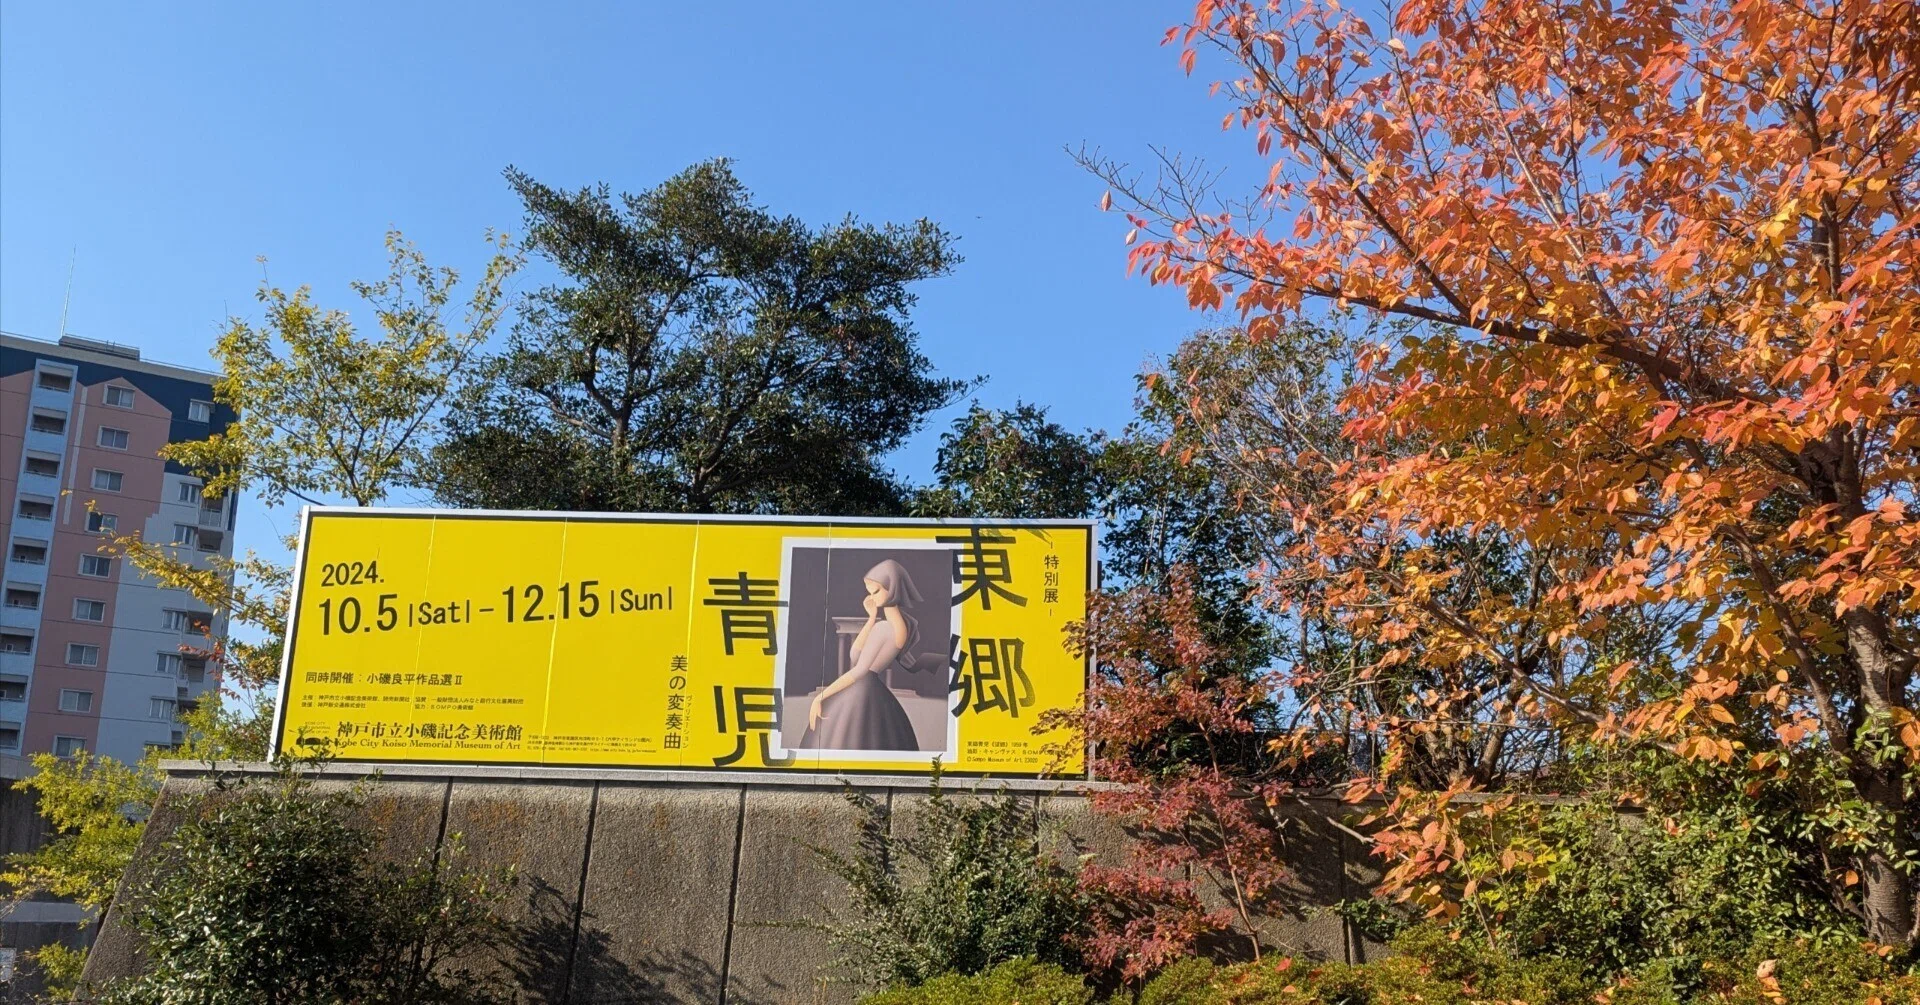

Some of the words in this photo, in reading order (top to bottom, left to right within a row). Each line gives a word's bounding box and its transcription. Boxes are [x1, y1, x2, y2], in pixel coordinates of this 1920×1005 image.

[321, 560, 385, 587] 2024.
[318, 593, 398, 636] 10.5
[502, 580, 600, 624] 12.15
[936, 527, 1036, 718] 東郷
[703, 571, 797, 768] 青児
[663, 654, 688, 750] 美の変奏曲
[337, 721, 523, 741] 神戸市立小磯記念美術館
[360, 738, 380, 748] City
[382, 739, 407, 748] Koiso
[409, 739, 452, 749] Memorial
[454, 741, 492, 750] Museum
[494, 740, 504, 750] of
[506, 742, 521, 750] Art
